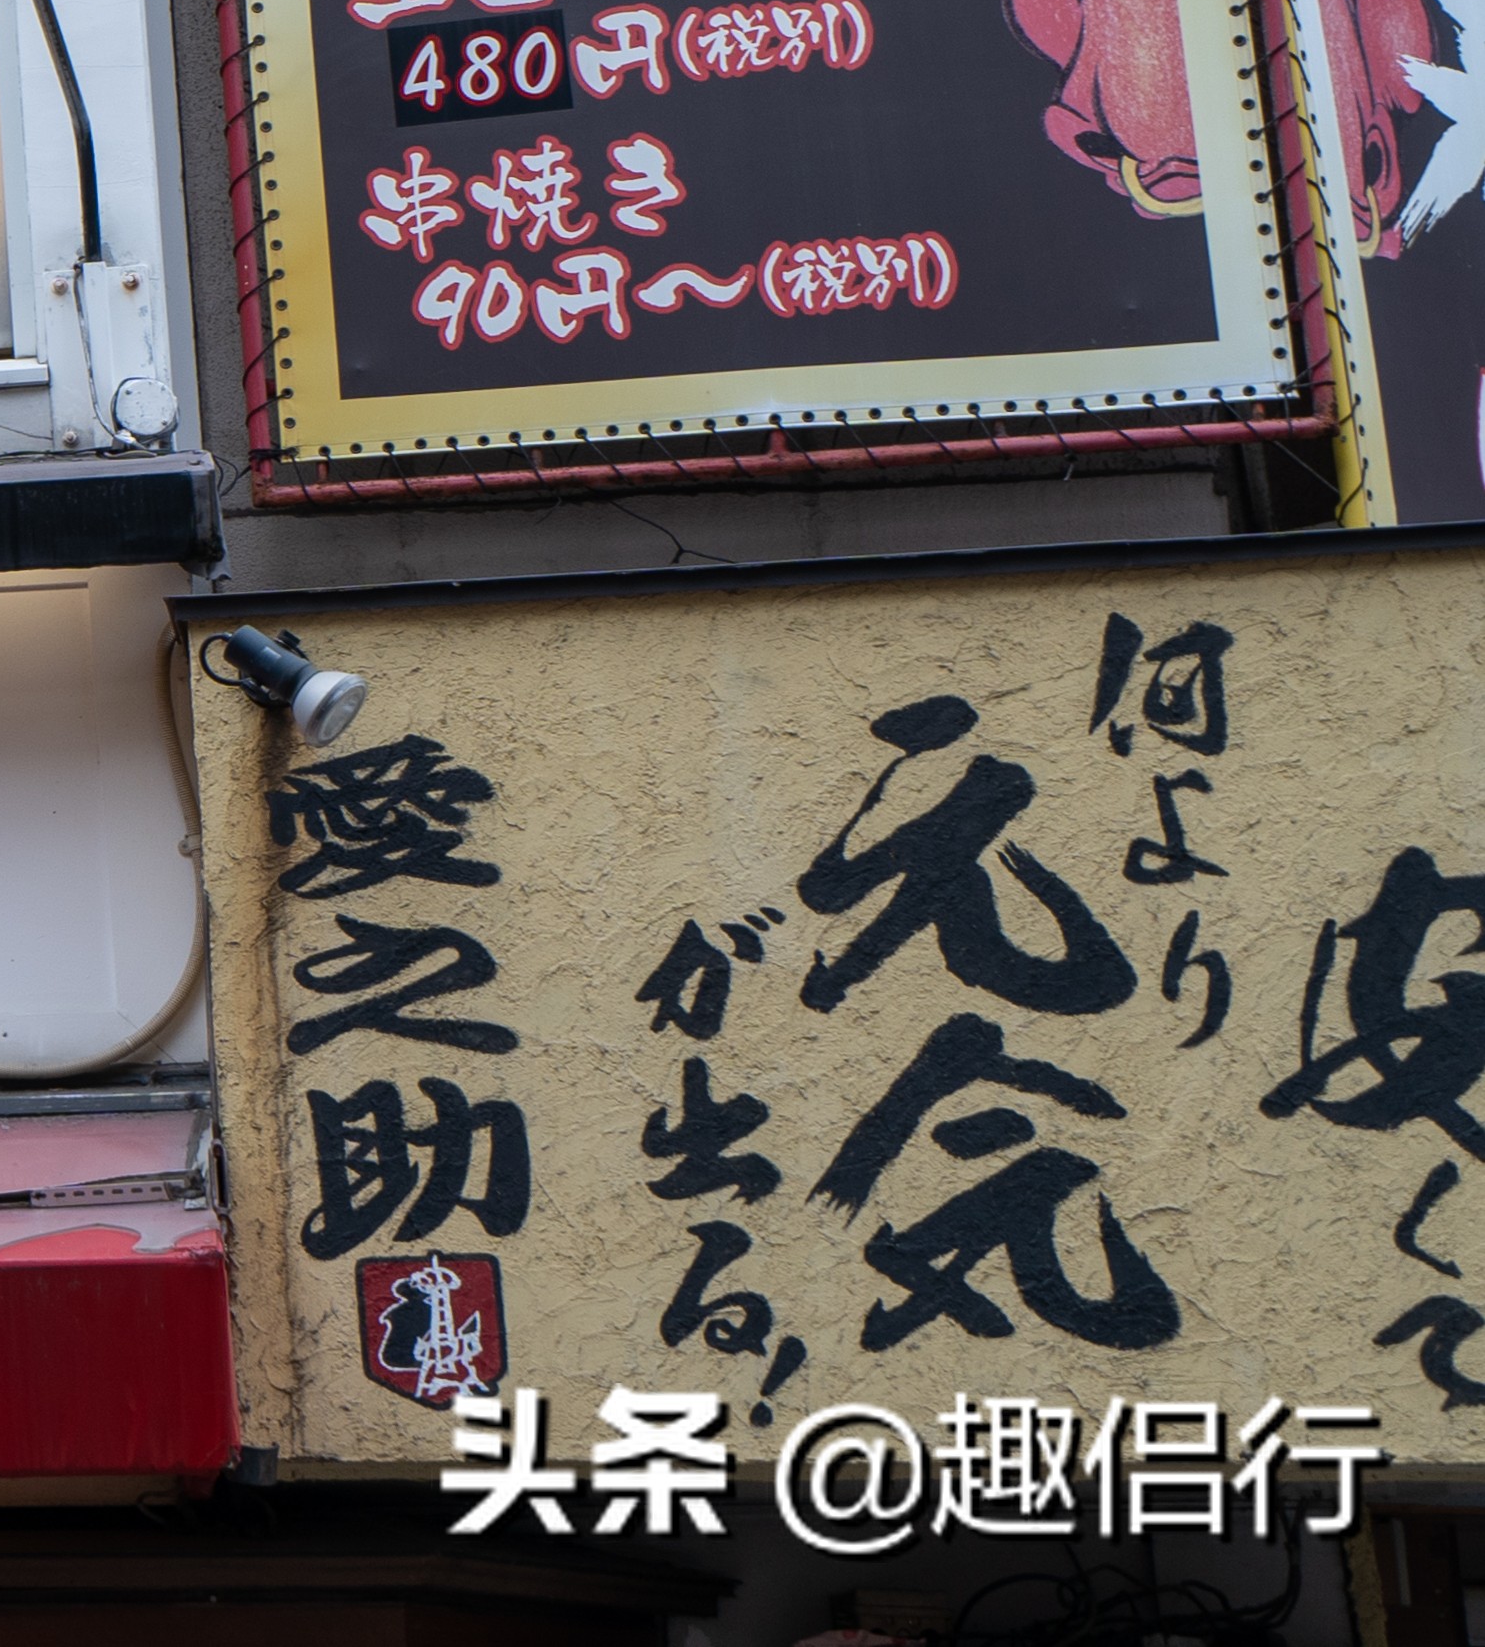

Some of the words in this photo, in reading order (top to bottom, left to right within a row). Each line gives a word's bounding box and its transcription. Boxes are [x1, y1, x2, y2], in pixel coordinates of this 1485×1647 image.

[359, 133, 687, 262] 串焼き
[265, 733, 533, 1262] 愛之助
[796, 693, 1182, 1352] 元気
[1088, 611, 1234, 1050] 何より
